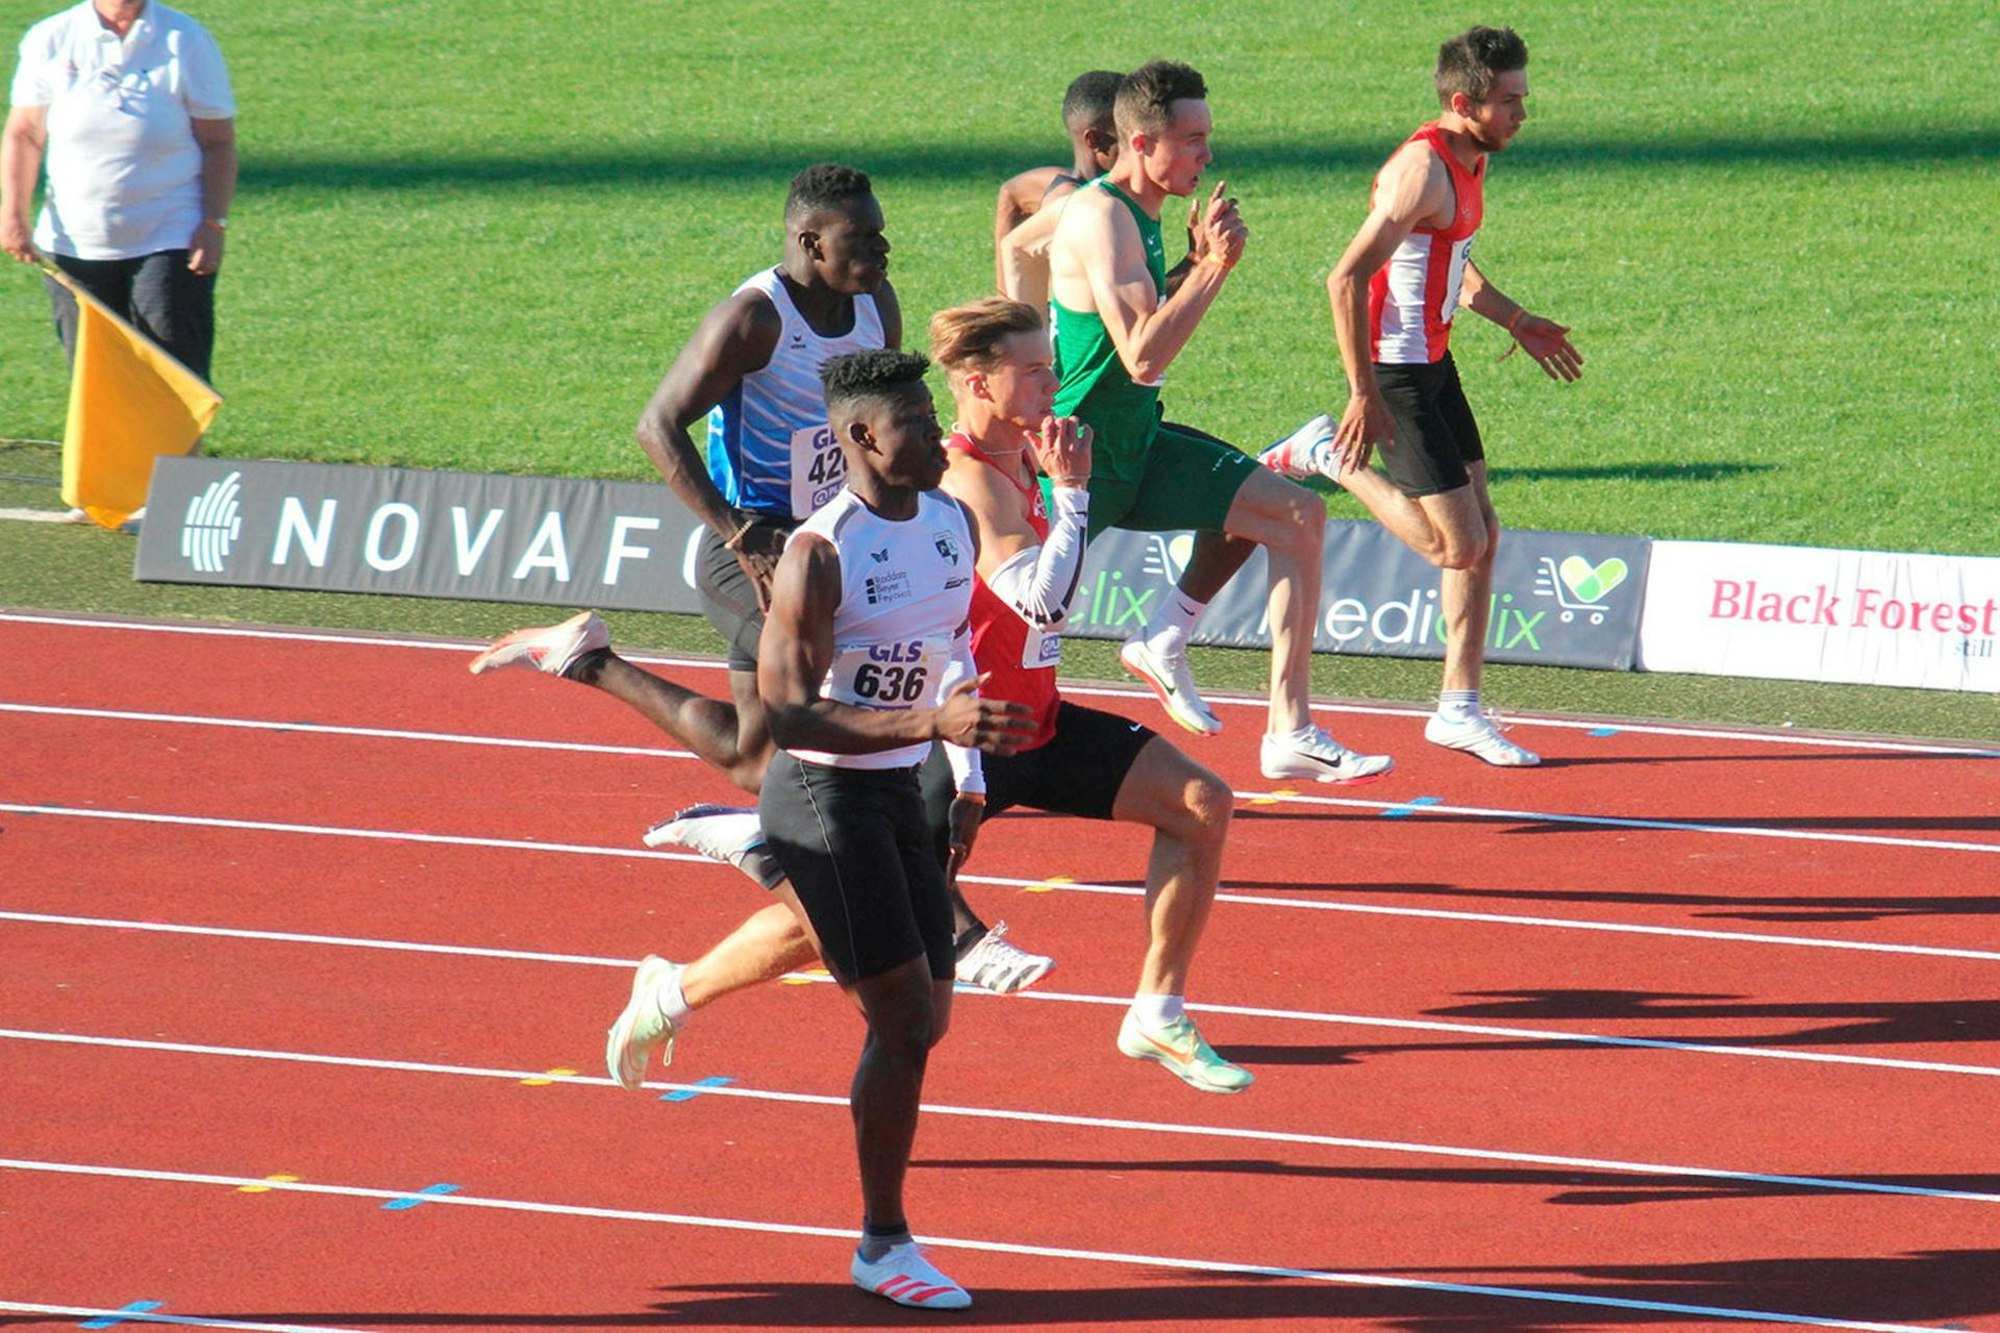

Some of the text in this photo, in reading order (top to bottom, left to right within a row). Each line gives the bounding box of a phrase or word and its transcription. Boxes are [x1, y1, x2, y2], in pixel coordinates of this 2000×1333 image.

[1246, 588, 1546, 651] edilix
[1709, 579, 1998, 636] Black Forest
[854, 664, 928, 702] 636
